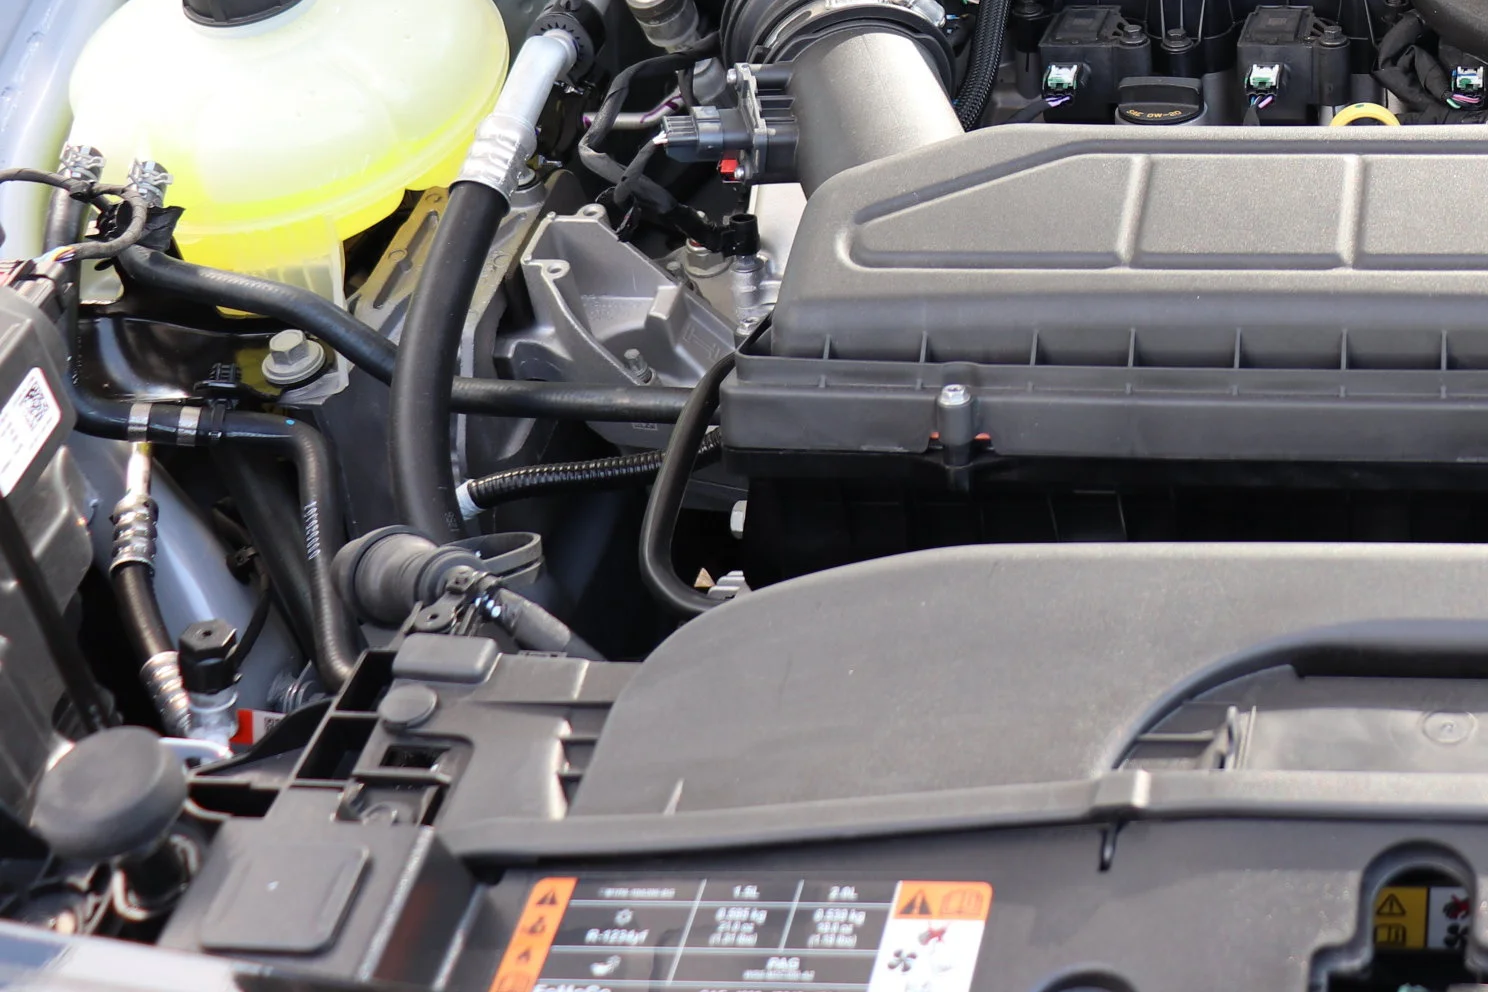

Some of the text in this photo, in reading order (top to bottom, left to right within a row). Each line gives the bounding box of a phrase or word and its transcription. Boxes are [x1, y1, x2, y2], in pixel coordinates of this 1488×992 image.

[1126, 109, 1183, 119] SAE 0W-20
[584, 928, 650, 946] R-1234yf
